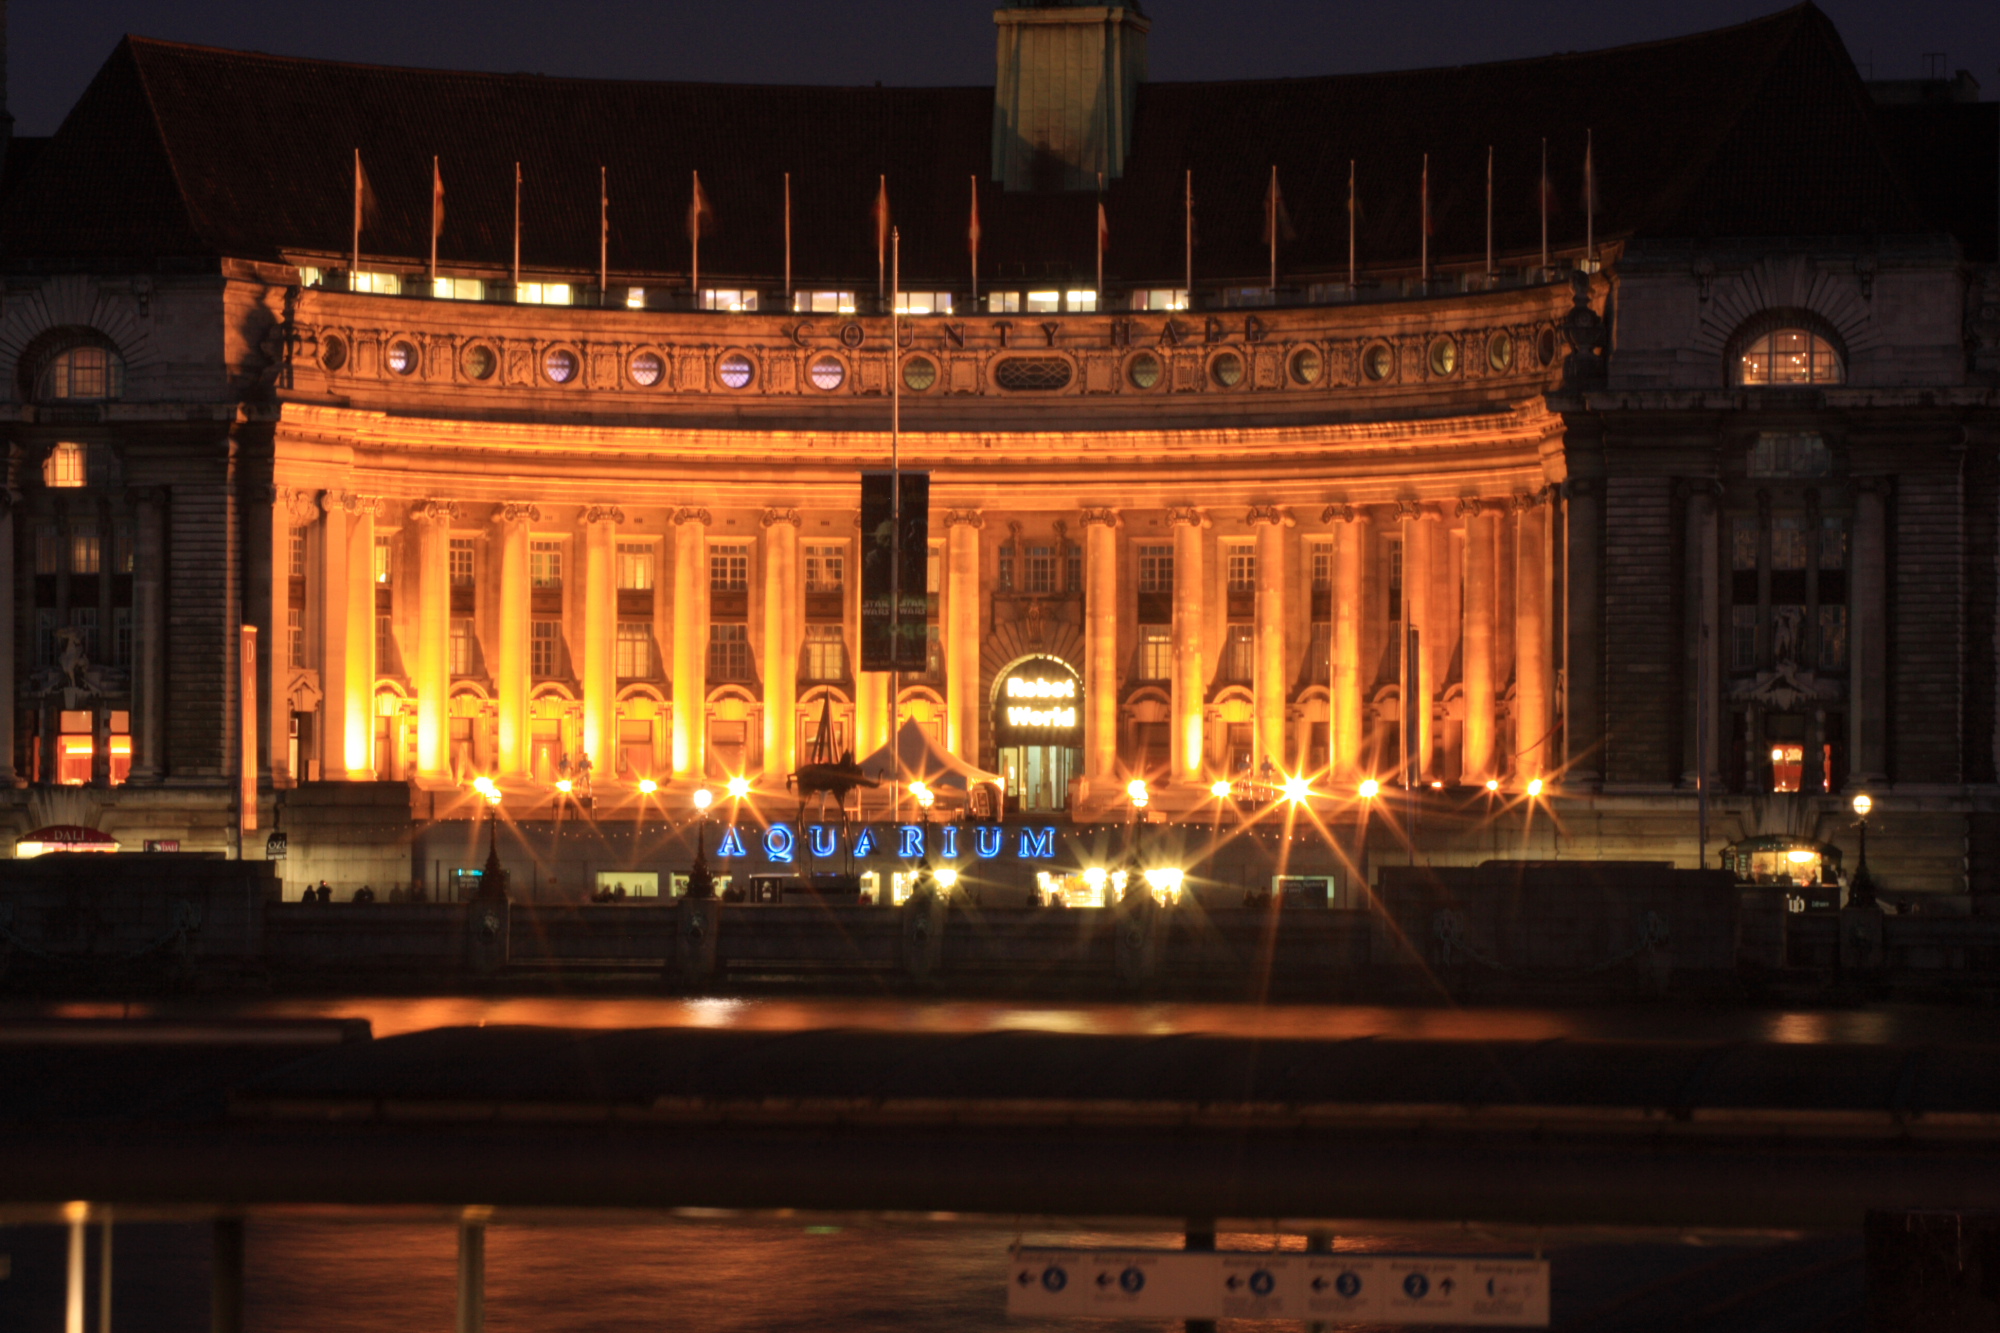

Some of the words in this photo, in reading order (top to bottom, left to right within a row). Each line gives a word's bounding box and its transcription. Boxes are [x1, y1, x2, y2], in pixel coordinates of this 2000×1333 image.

[791, 321, 1060, 348] COUNTY
[1109, 317, 1261, 346] HALL
[863, 608, 890, 616] WARS
[899, 607, 926, 616] WARS
[1007, 677, 1075, 698] Robot
[1006, 706, 1076, 727] World
[717, 823, 1055, 863] AQUARIUM
